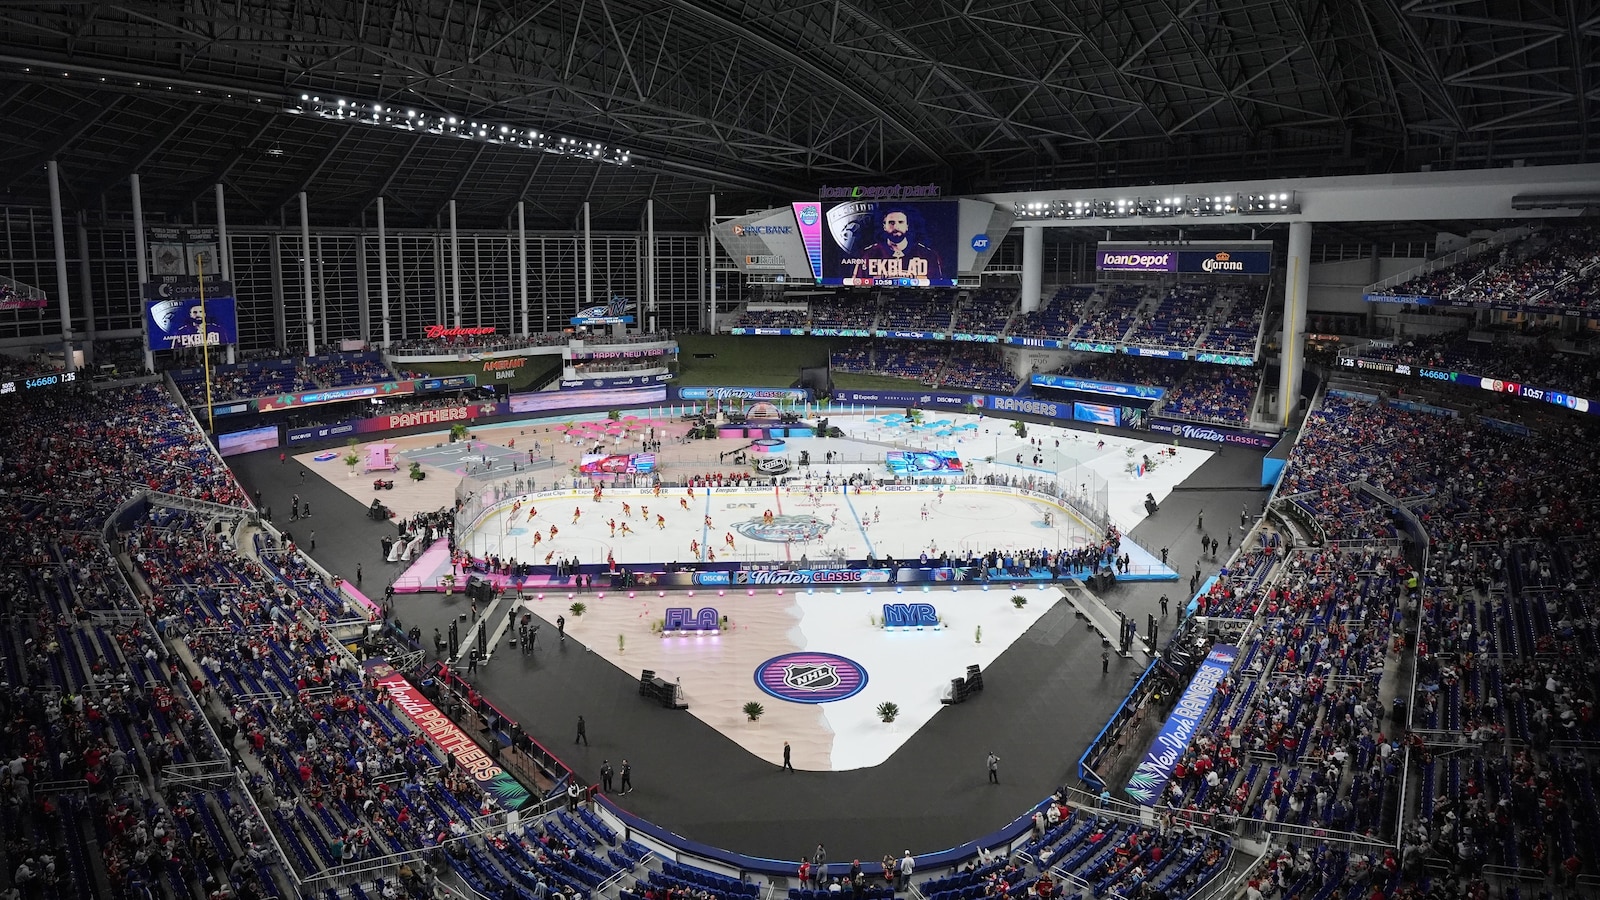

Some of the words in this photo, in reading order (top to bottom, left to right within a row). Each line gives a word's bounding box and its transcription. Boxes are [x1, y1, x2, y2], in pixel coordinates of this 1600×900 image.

[821, 184, 900, 198] loanDepot
[902, 184, 937, 198] park
[973, 239, 988, 248] ADT
[868, 258, 928, 276] EKBLAD
[1103, 253, 1168, 268] loanDepot
[1202, 258, 1243, 272] Corona
[423, 325, 496, 338] Budweiser
[623, 350, 641, 358] NEW
[644, 348, 664, 356] YEAR!
[495, 370, 516, 380] BANK
[655, 373, 673, 381] GEICO
[1419, 368, 1449, 380] $46680
[25, 376, 58, 389] $46680
[716, 387, 754, 400] Winter
[754, 390, 785, 398] CLASSIC
[936, 396, 962, 404] DISCOVER
[1507, 384, 1514, 393] 0
[1522, 387, 1544, 400] 10:57
[1556, 395, 1563, 404] 0
[994, 397, 1057, 417] RANGERS
[389, 407, 468, 429] PANTHERS
[290, 433, 312, 441] DISCOVER
[1151, 424, 1172, 432] DISCOVER
[1182, 425, 1224, 442] Winter
[1225, 434, 1260, 446] CLASSIC
[751, 571, 811, 585] Winter
[813, 571, 862, 582] CLASSIC
[665, 608, 719, 630] FLA
[883, 603, 938, 626] NYR
[795, 667, 829, 686] NHL
[1175, 665, 1225, 721] RANGERS
[378, 679, 424, 715] Florida
[416, 709, 502, 782] PANTHERS
[1158, 717, 1196, 757] York
[1148, 744, 1179, 779] New
